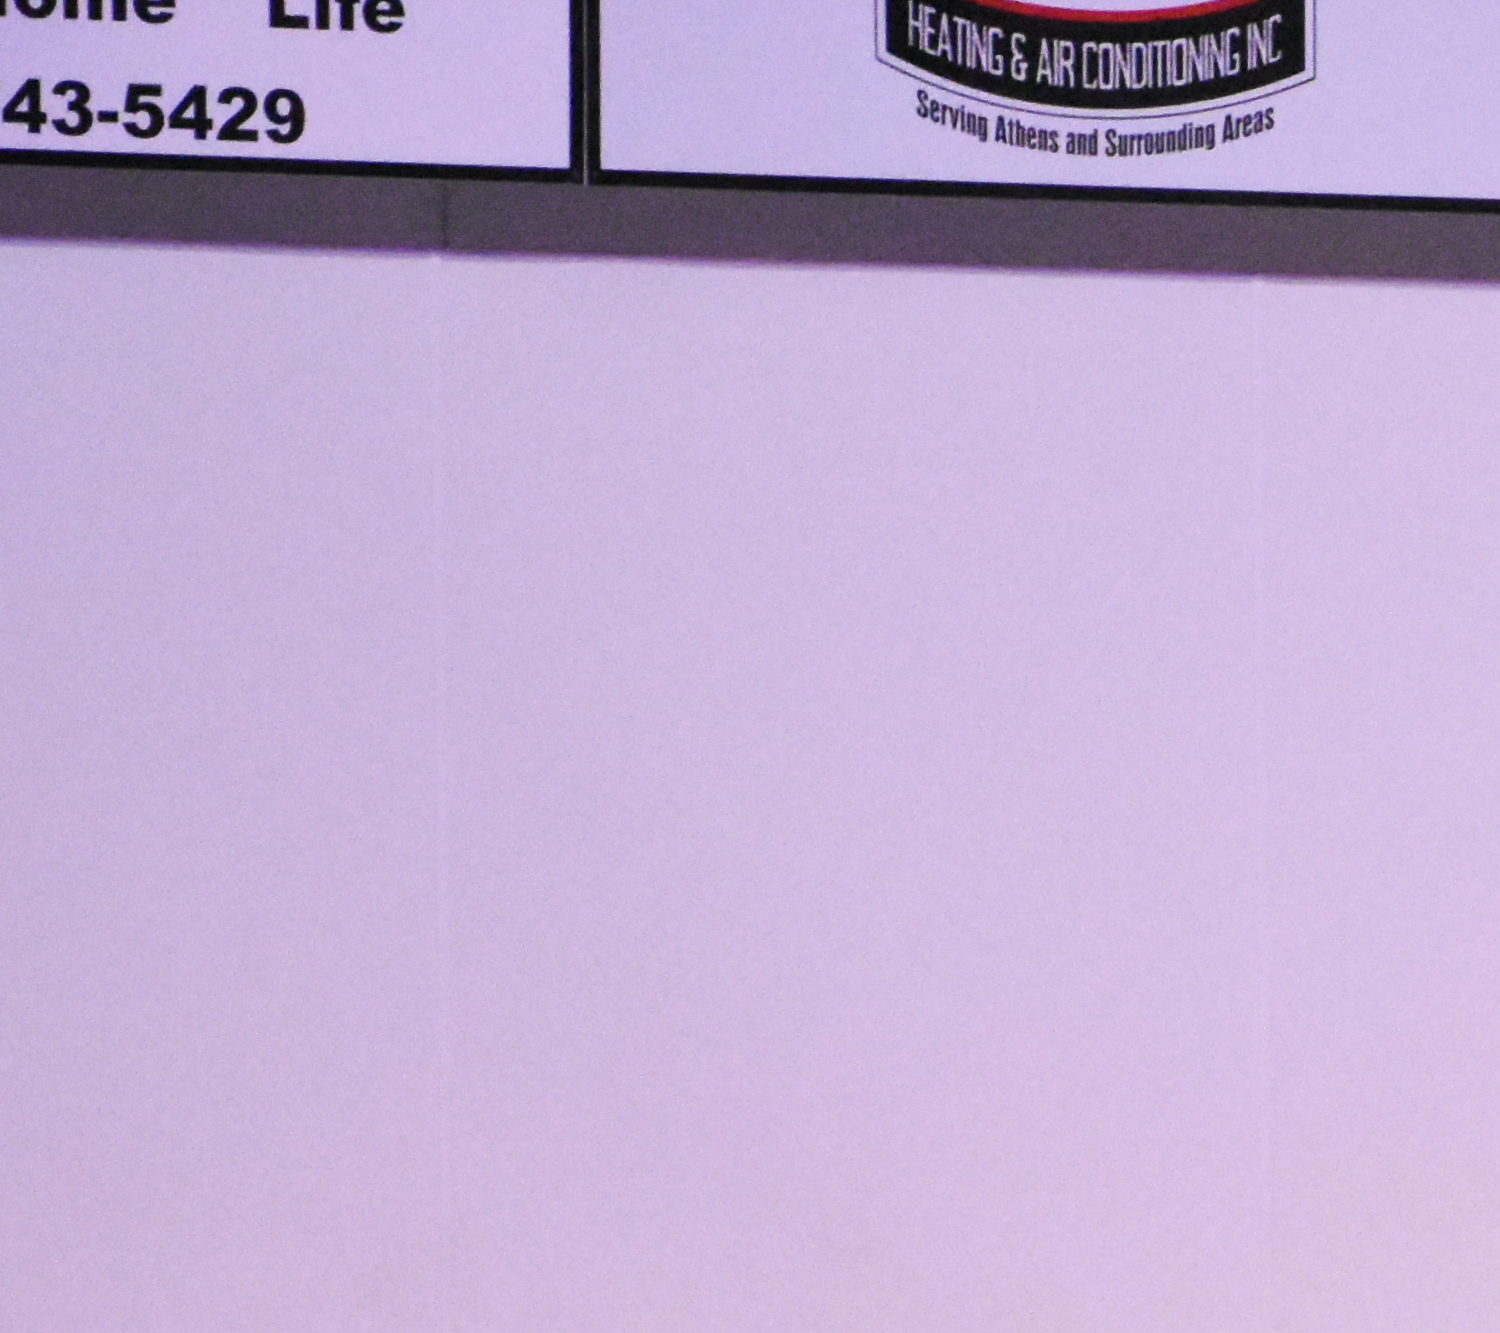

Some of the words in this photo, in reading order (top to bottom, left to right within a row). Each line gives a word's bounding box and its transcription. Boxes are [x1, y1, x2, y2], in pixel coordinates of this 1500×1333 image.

[0, 0, 176, 24] ome
[908, 0, 1004, 76] HEATING
[1011, 32, 1028, 81] &
[1037, 37, 1075, 88] AIR
[1082, 27, 1241, 90] CONDITIONING
[1247, 13, 1282, 71] INC
[916, 89, 988, 142] Serving
[995, 115, 1059, 153] Athens
[1066, 128, 1098, 156] and
[1105, 122, 1215, 157] Surrounding
[1223, 107, 1275, 143] Areas
